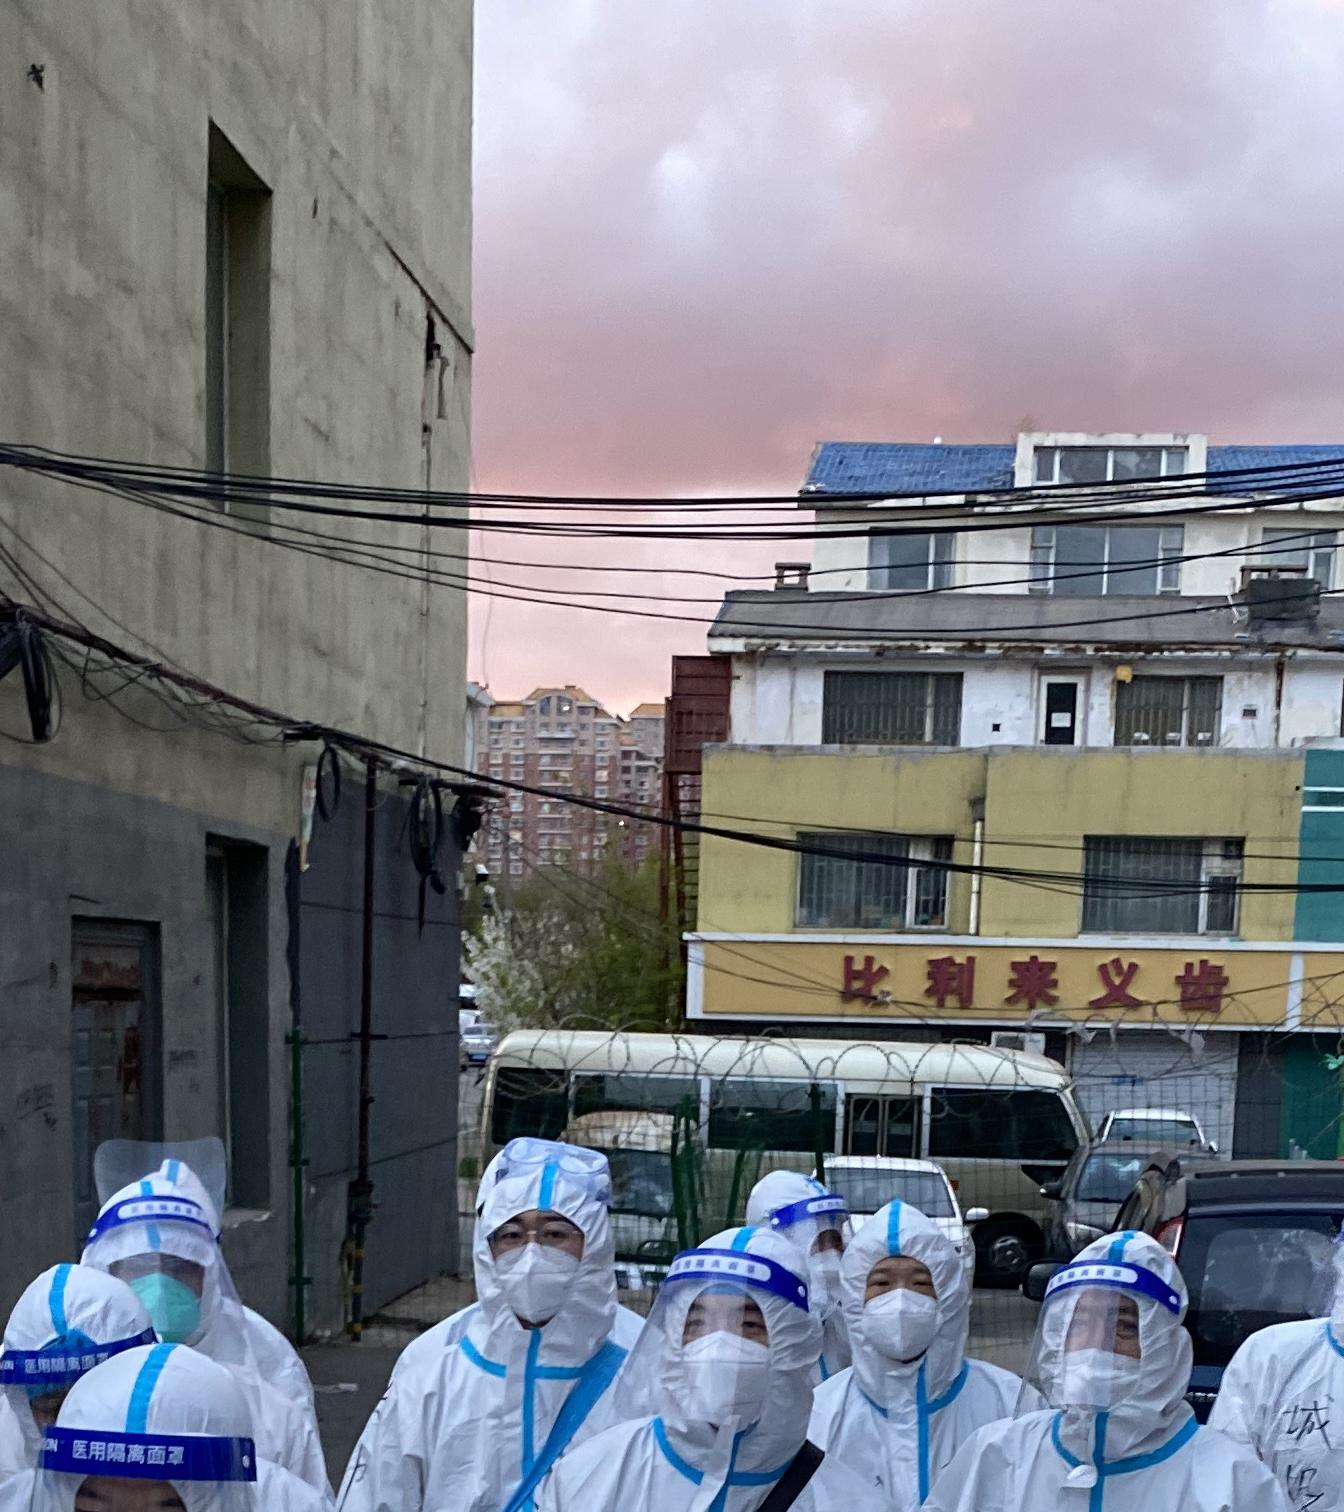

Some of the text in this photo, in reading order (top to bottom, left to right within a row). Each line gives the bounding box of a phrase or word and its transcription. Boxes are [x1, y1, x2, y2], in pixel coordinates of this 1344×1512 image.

[841, 955, 1230, 1014] 比利来义齿
[72, 1439, 185, 1466] 医用隔离面罩
